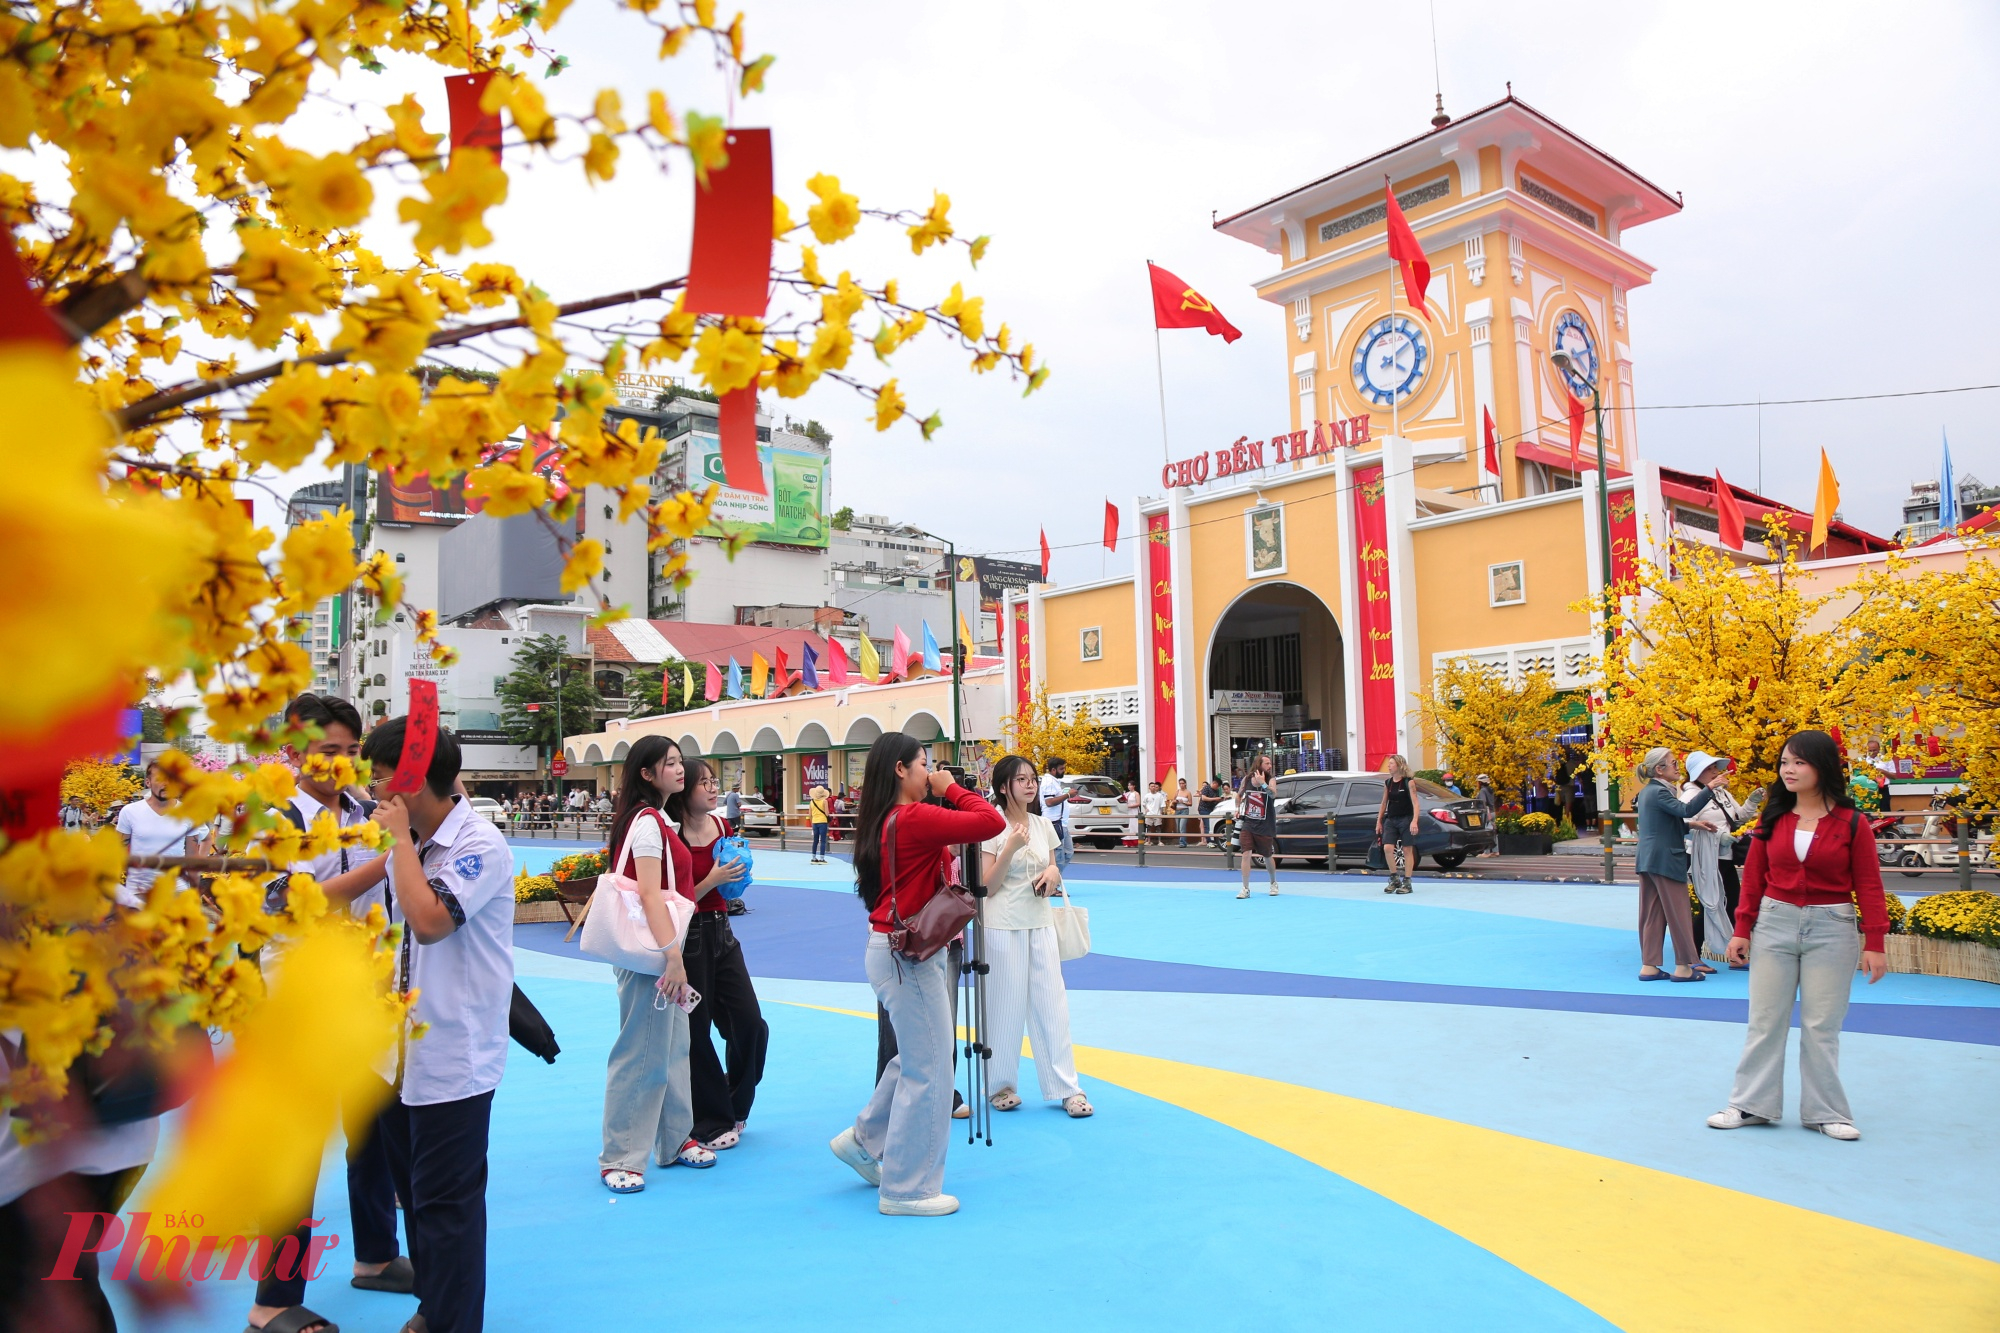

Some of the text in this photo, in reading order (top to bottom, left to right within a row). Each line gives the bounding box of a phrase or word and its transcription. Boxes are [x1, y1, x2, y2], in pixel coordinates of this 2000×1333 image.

[1161, 413, 1372, 489] CHỢ BẾN THÀNH
[729, 501, 748, 511] NHỊP
[749, 502, 769, 512] SỐNG
[778, 504, 807, 521] MATCHA
[803, 758, 825, 781] Vikki
